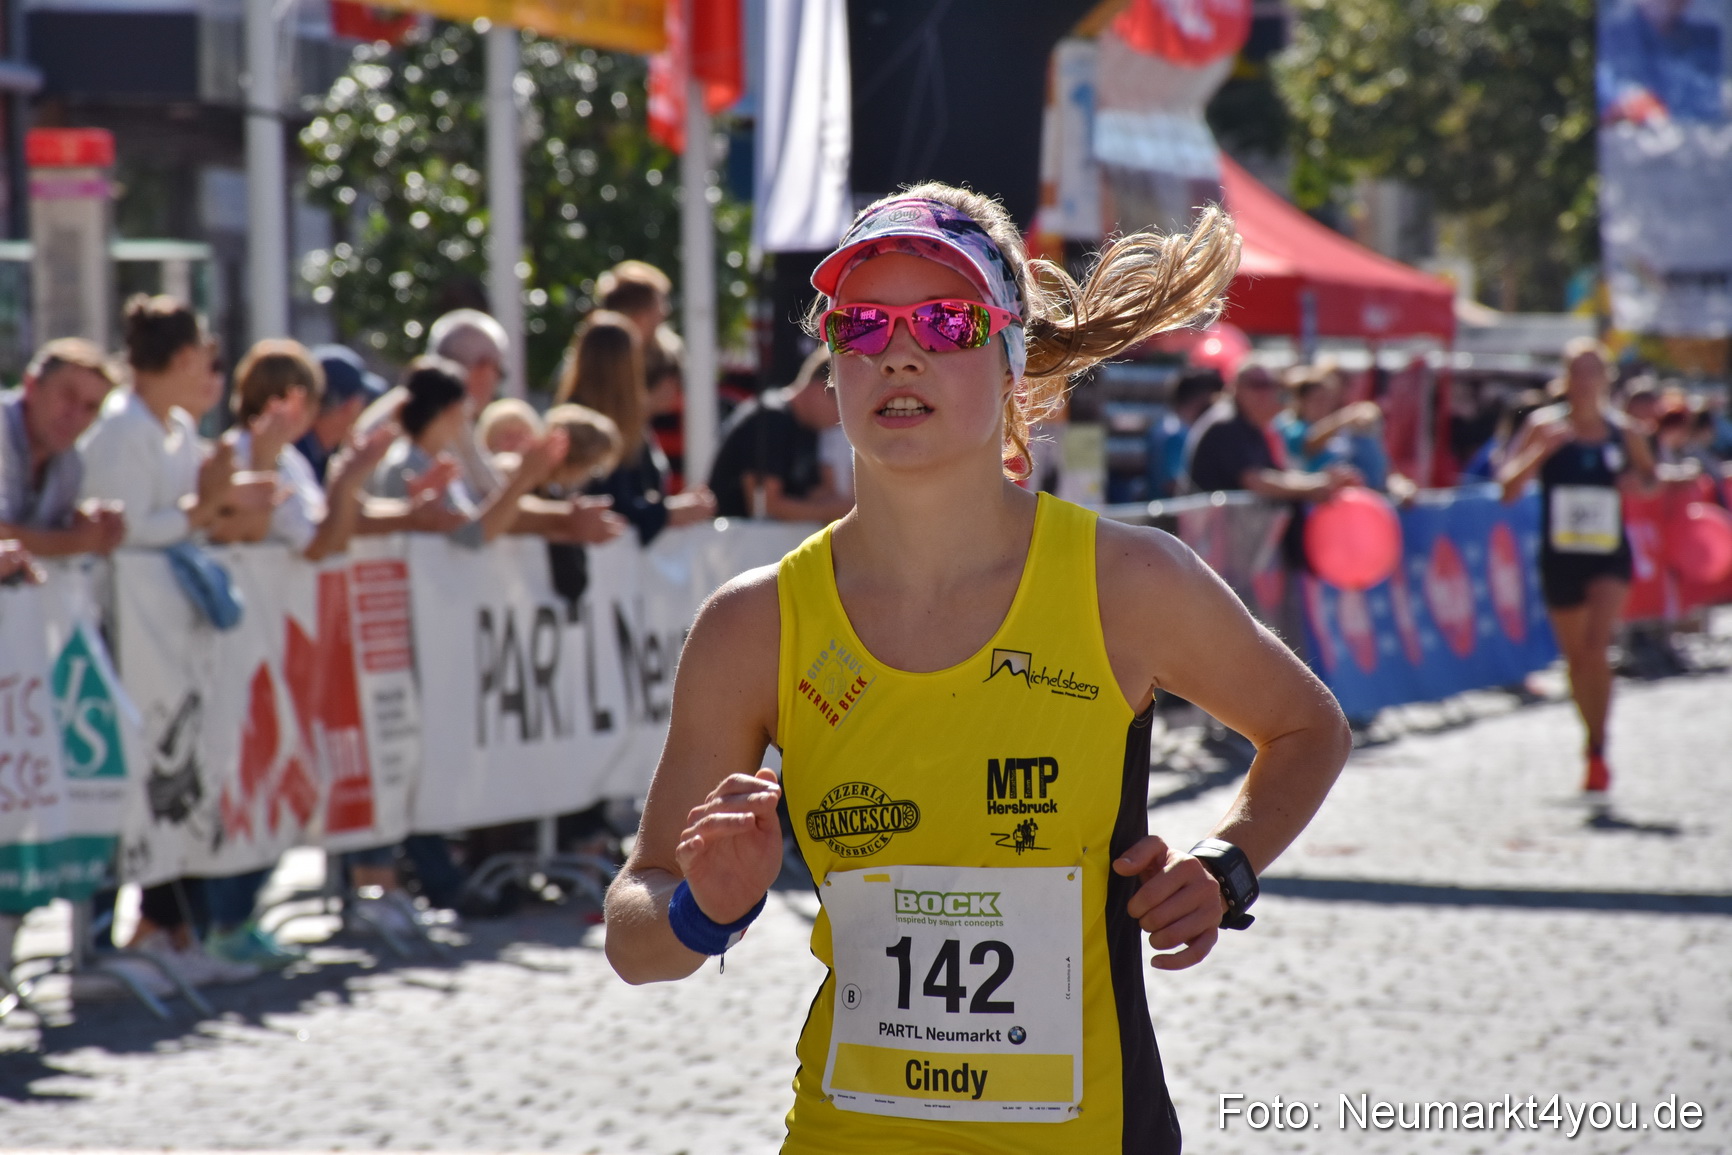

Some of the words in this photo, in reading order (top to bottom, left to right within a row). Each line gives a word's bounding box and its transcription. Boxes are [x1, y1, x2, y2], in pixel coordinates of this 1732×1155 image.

[893, 210, 917, 220] Buff
[807, 650, 829, 680] GELD
[836, 646, 864, 676] HAUS
[983, 653, 1100, 701] Michelsberg
[798, 678, 840, 727] WERNER
[838, 675, 868, 711] BECK
[987, 756, 1059, 800] MTP
[821, 784, 887, 811] PIZZERIA
[987, 798, 1058, 815] Hersbruck
[813, 805, 903, 838] FRANCESCO
[827, 833, 889, 857] HERSBRUCK
[894, 888, 1003, 918] BOCK
[895, 914, 927, 925] inspired
[928, 917, 938, 927] by
[939, 919, 962, 927] smart
[964, 919, 1004, 928] concepts
[885, 936, 1015, 1014] 142
[847, 989, 856, 1004] B
[878, 1021, 923, 1040] PARTL
[925, 1024, 1002, 1043] Neumarkt
[904, 1059, 989, 1100] Cindy
